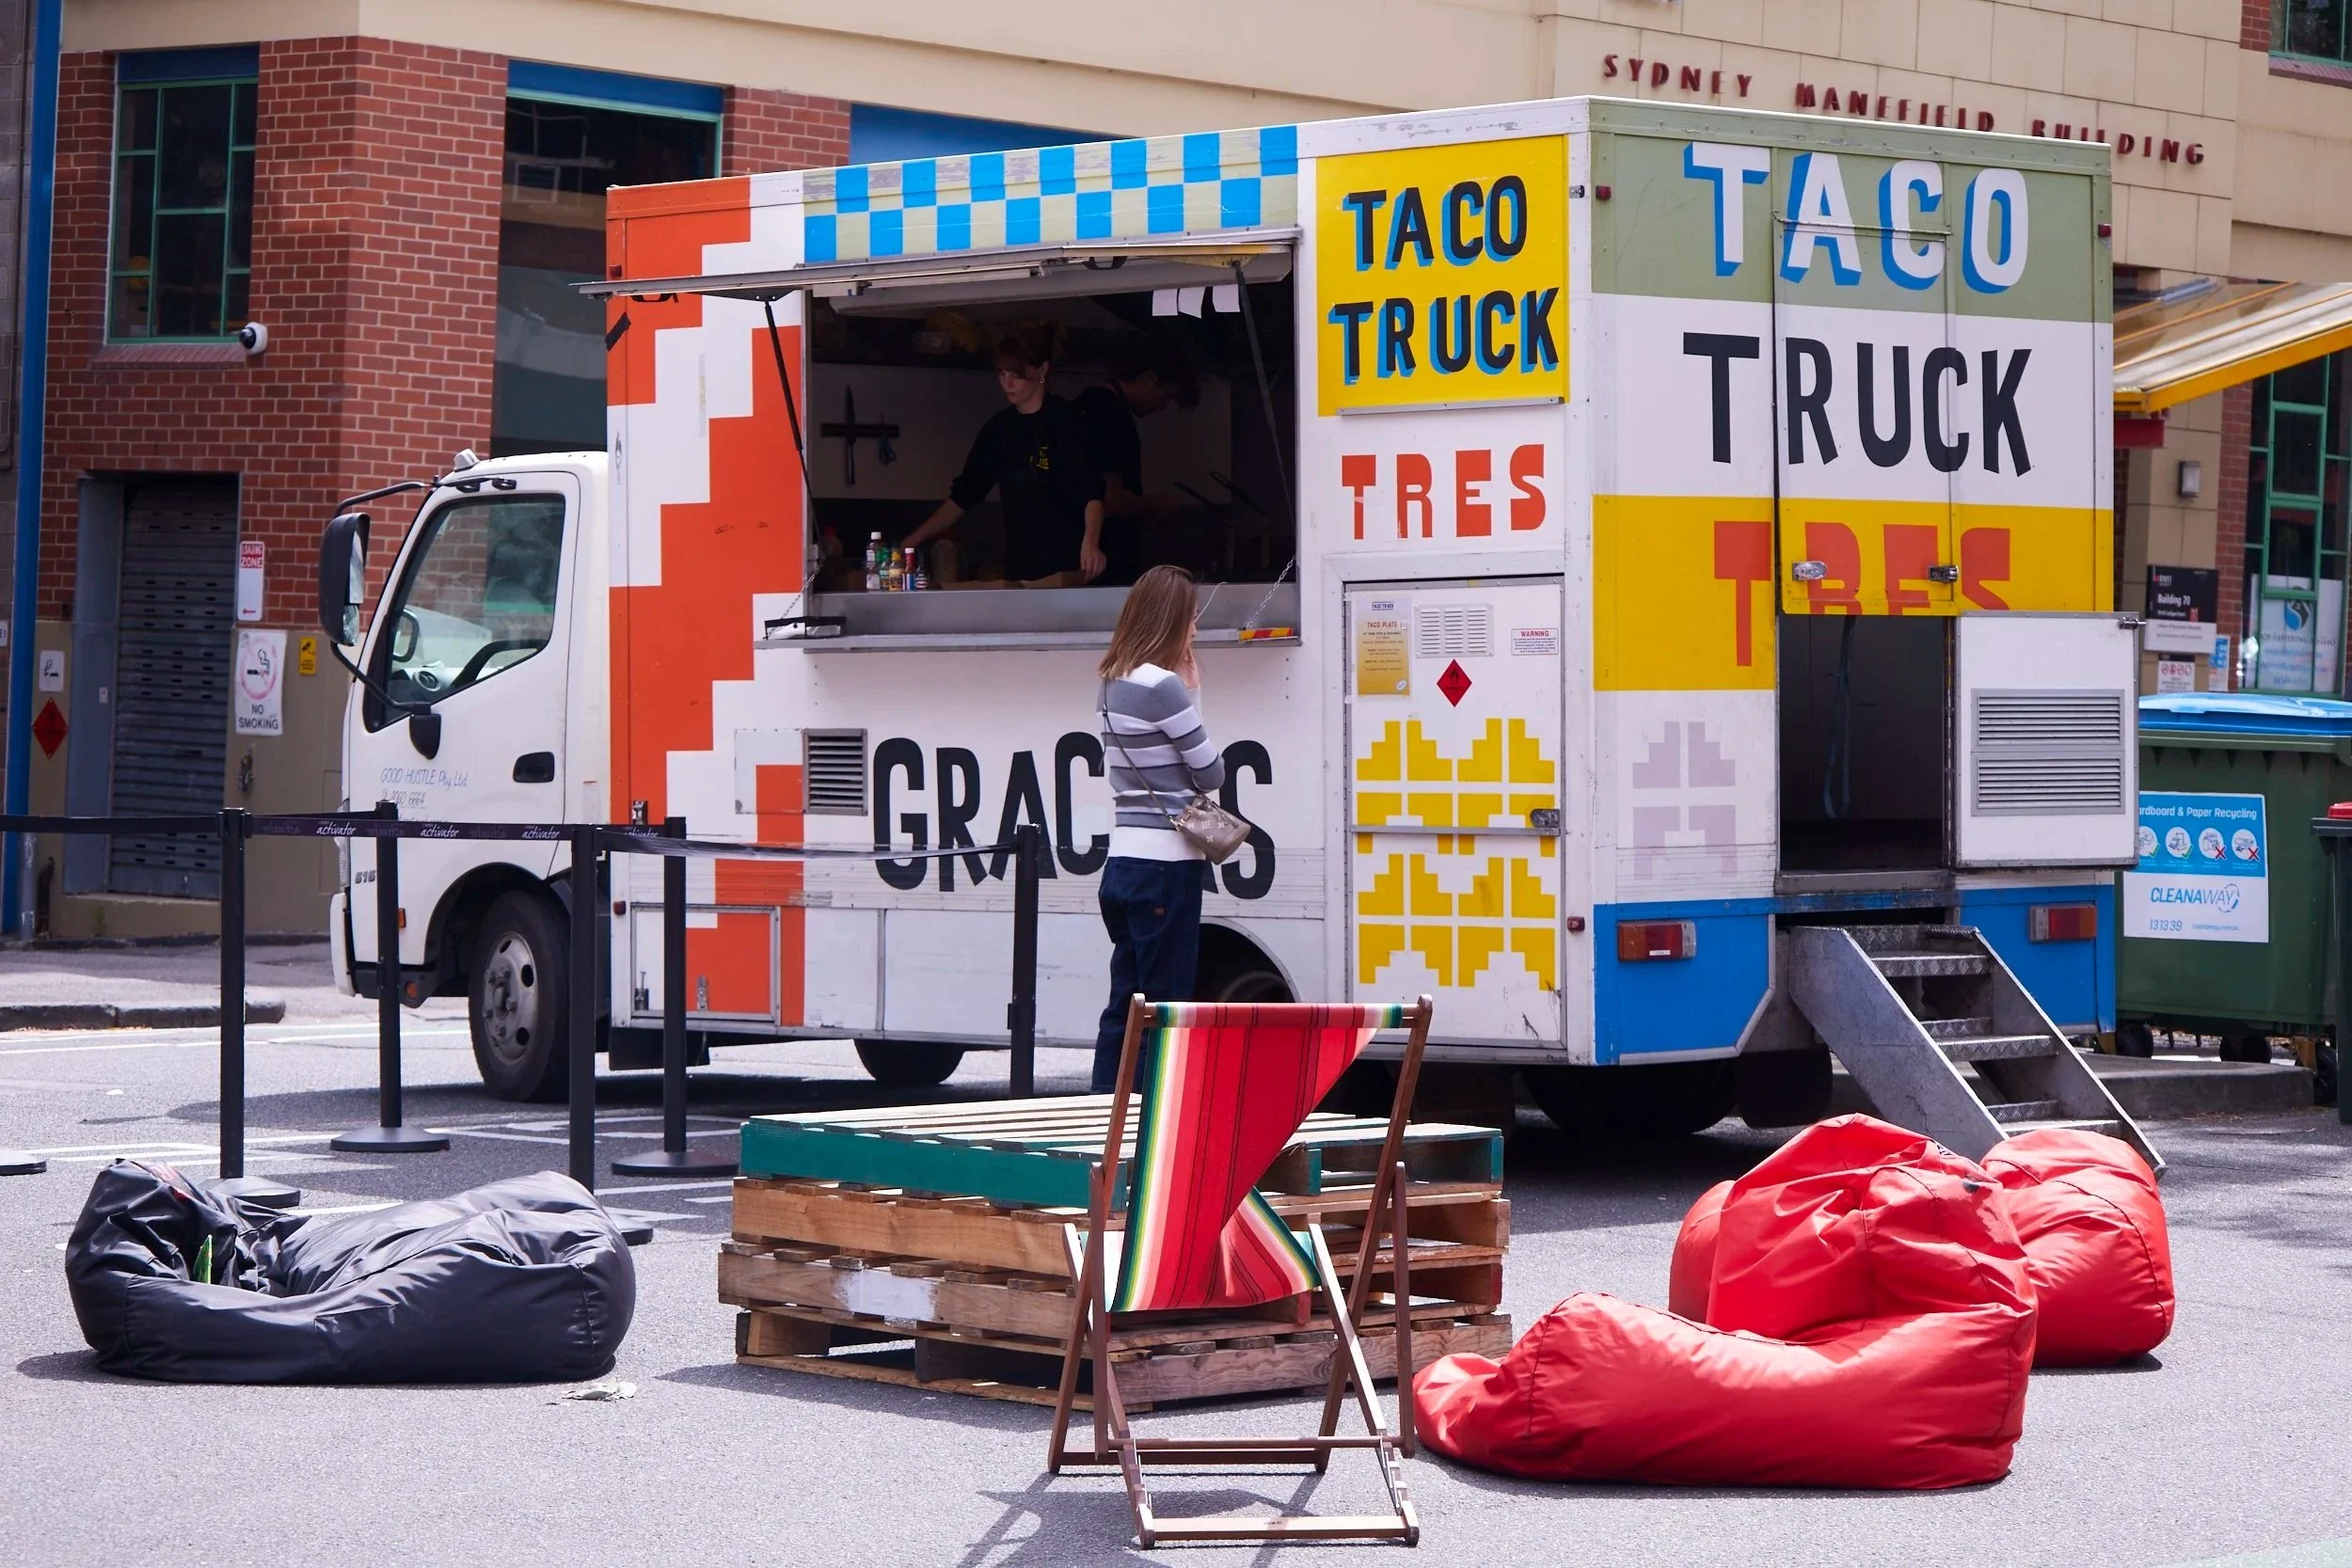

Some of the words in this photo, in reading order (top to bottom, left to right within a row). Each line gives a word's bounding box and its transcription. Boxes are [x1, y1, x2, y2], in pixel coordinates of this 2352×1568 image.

[1603, 54, 1753, 98] SYDNEY
[1343, 175, 1527, 272] TACO
[1683, 141, 2028, 293] TACO
[1328, 287, 1559, 386] TRUCK
[1683, 332, 2032, 477] TRUCK
[1342, 444, 1546, 540] TRES
[241, 557, 262, 567] ZONE
[2157, 594, 2182, 607] Building
[2183, 595, 2191, 606] 70
[251, 704, 263, 715] NO
[238, 717, 278, 730] SMOKING
[381, 768, 405, 784] GOOD
[405, 768, 436, 784] HUSTLE
[873, 732, 1276, 900] GRACS
[2186, 807, 2212, 819] Paper
[2214, 807, 2257, 820] Recycling
[316, 821, 357, 835] activator
[420, 824, 459, 838] activator
[521, 825, 561, 840] activator
[2151, 887, 2235, 905] CLEANAWAY
